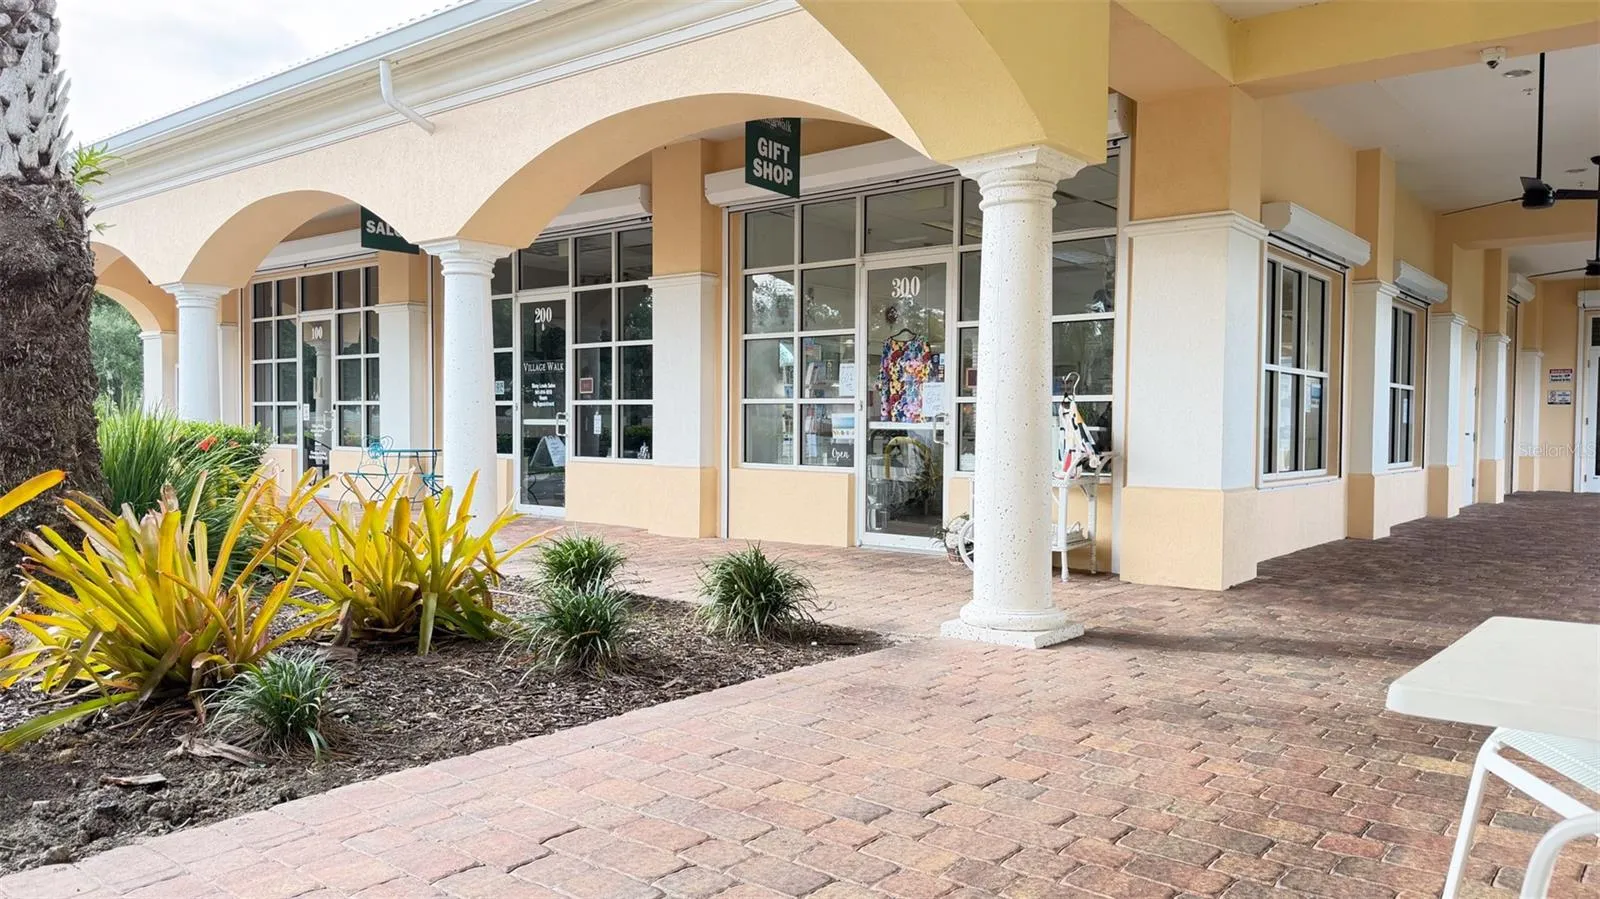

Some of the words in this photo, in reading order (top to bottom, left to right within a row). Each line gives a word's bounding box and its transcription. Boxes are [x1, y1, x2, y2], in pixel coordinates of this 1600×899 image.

[757, 137, 790, 164] GIFT
[753, 158, 793, 186] SHOP
[891, 276, 920, 297] 300
[534, 307, 552, 323] 200
[311, 326, 323, 340] 100
[832, 447, 849, 462] Open
